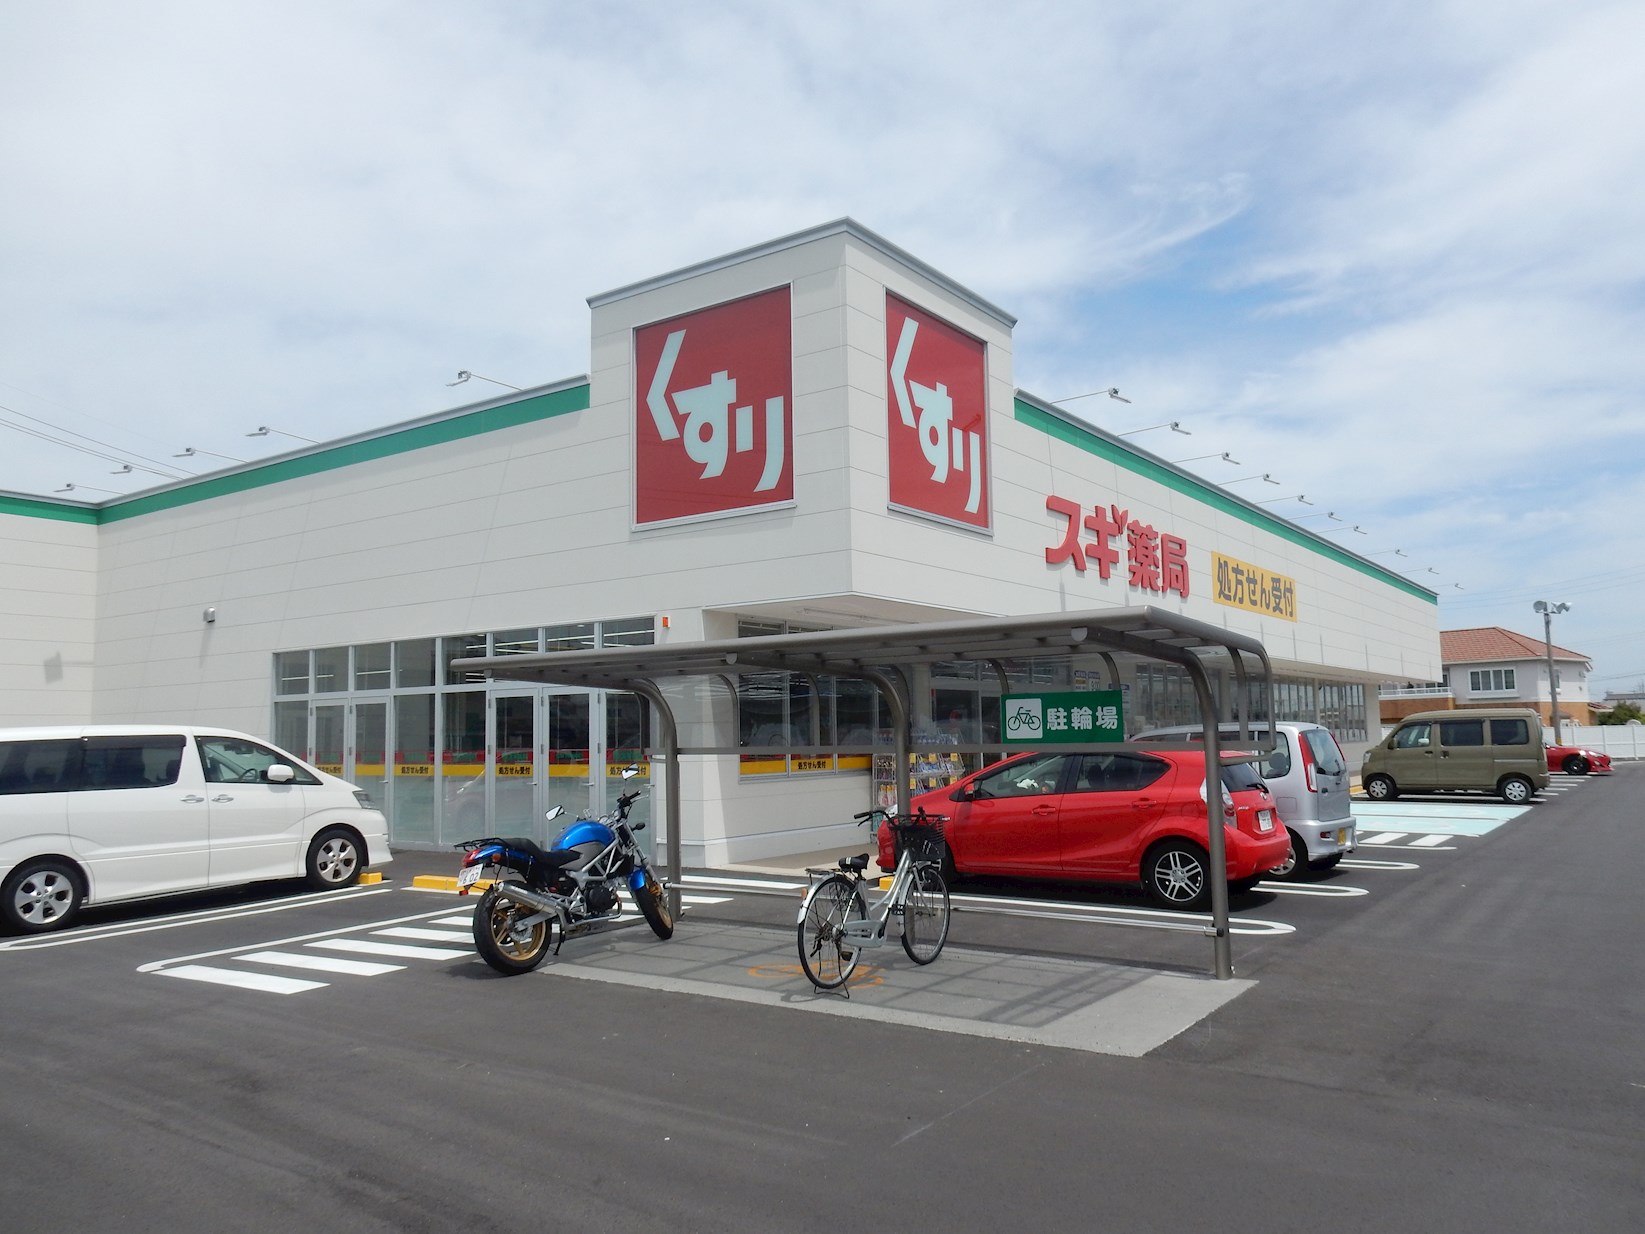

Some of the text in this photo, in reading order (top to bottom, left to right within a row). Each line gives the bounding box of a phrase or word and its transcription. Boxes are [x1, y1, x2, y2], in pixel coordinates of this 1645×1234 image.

[646, 329, 785, 493] くすり
[890, 317, 981, 514] くすり
[1045, 494, 1190, 599] スギ薬局
[1217, 557, 1293, 618] 処方せん受付
[1046, 706, 1118, 730] 駐輪場
[498, 766, 531, 775] 処方せん受付
[797, 761, 827, 770] 処方せん受付
